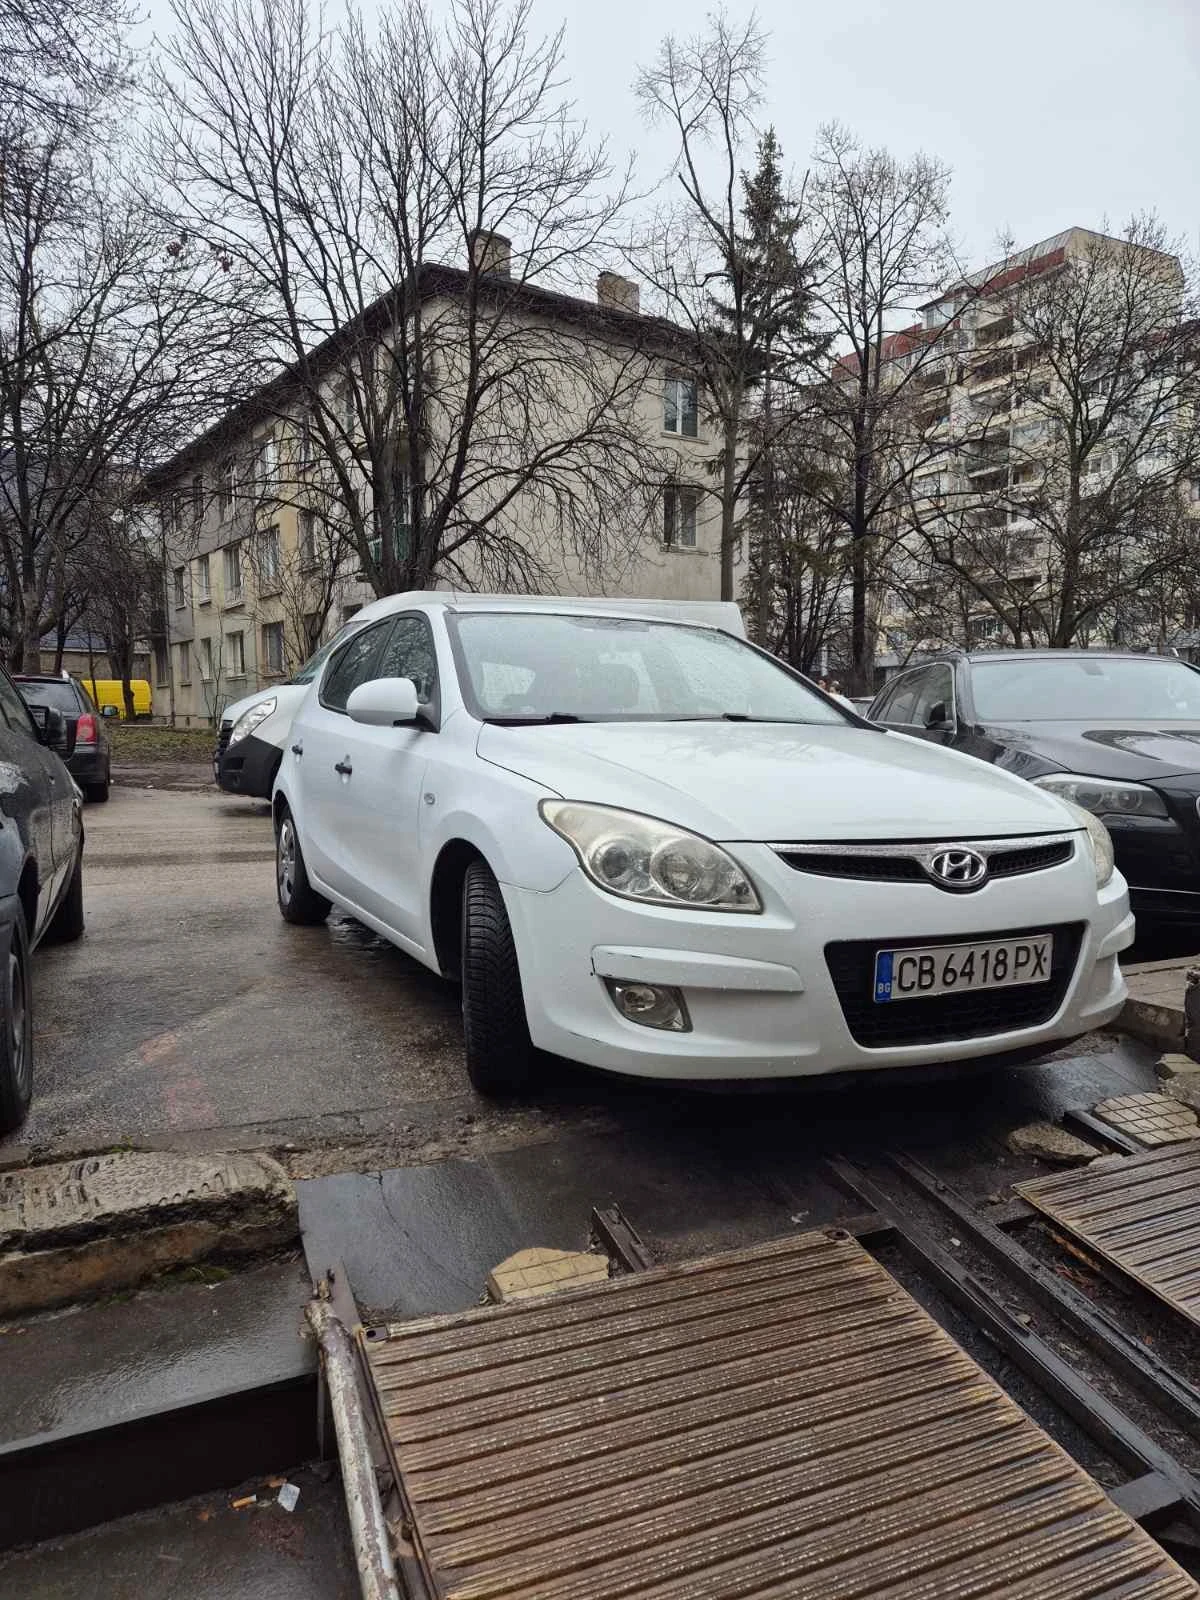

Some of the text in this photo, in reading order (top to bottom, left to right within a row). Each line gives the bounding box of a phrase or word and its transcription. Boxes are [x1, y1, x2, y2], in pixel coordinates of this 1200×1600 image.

[898, 943, 1047, 992] CB 6418 PX
[878, 982, 891, 993] BG
